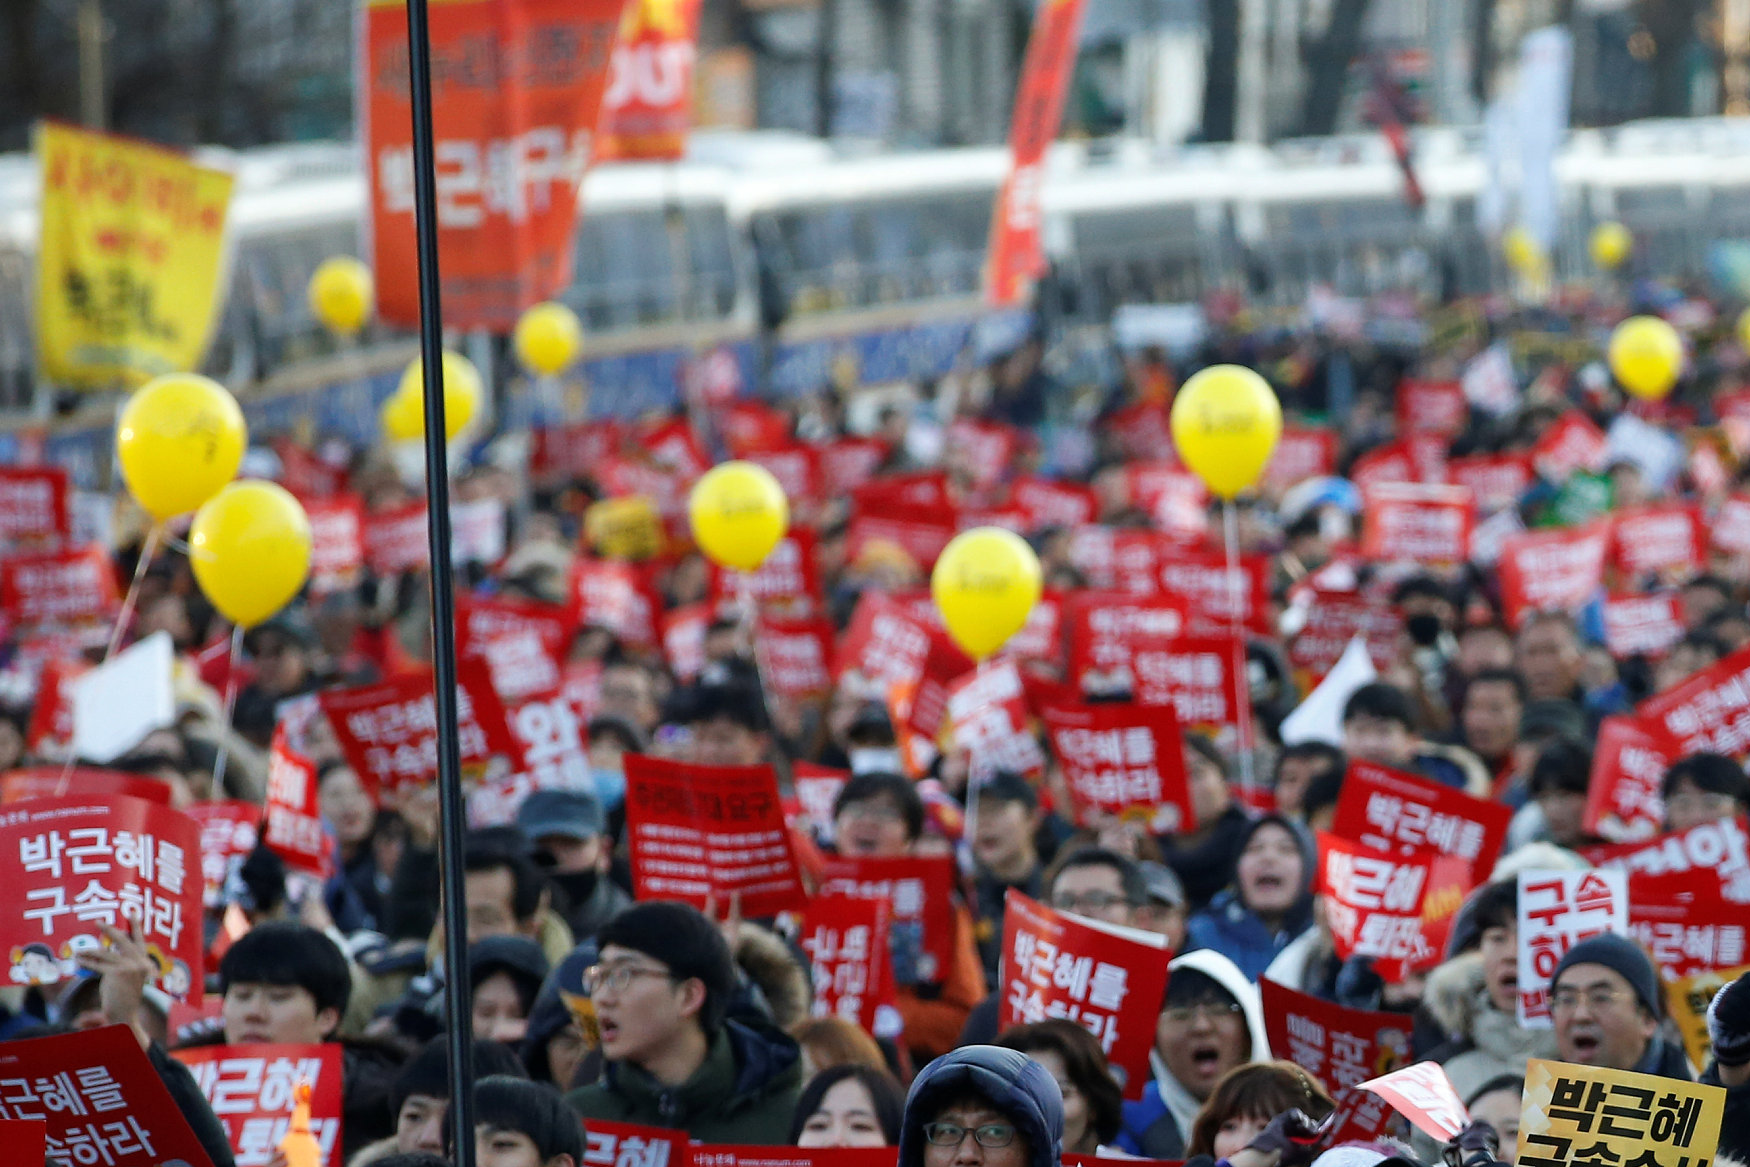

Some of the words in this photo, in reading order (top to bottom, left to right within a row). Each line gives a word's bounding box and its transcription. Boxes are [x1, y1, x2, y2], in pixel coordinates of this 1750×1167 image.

[19, 827, 187, 895] 박근혜를
[1326, 848, 1427, 912] 박근혜
[23, 879, 184, 952] 구속하라
[1526, 873, 1615, 926] 구속
[1014, 929, 1129, 1012] 박근혜를
[0, 1064, 128, 1123] 근혜를
[1547, 1078, 1703, 1149] 박근혜
